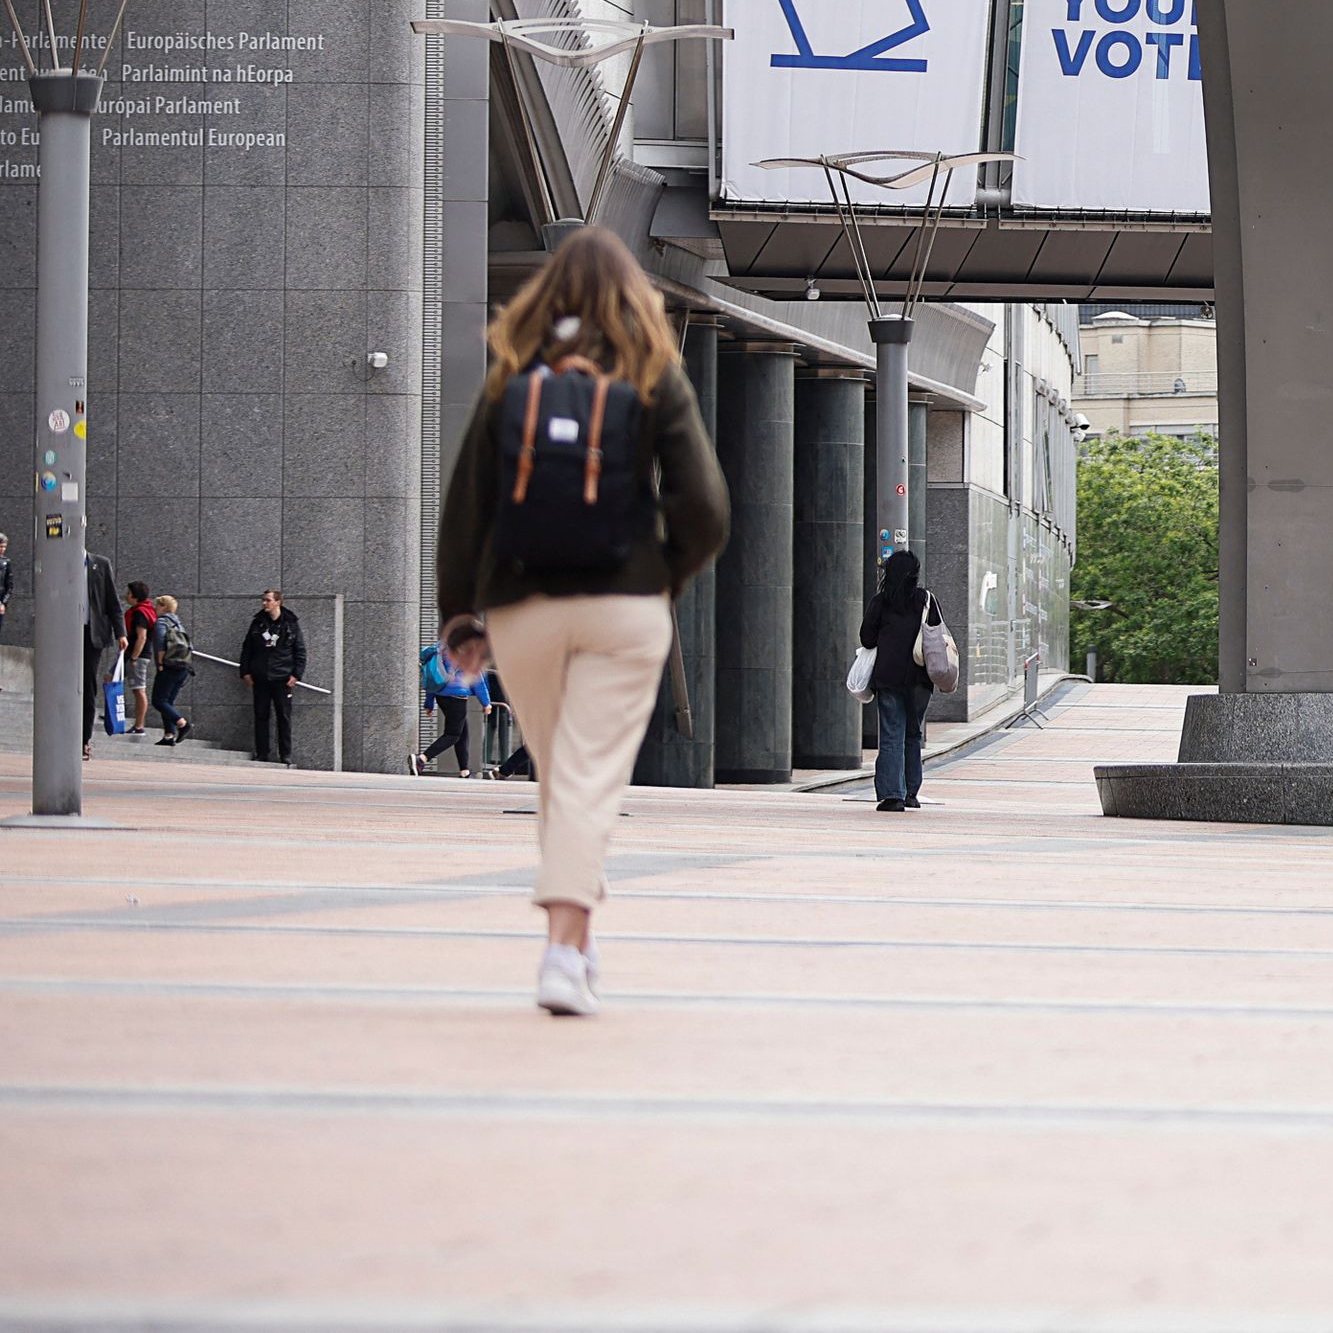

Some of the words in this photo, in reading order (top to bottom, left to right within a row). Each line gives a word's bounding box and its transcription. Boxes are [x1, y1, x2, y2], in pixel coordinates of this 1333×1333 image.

[127, 31, 234, 53] Europäisches
[239, 32, 324, 50] Parlament
[122, 64, 208, 82] Parlaimint
[212, 68, 232, 82] na
[236, 64, 294, 87] hEorpa
[95, 96, 150, 118] urópai
[155, 96, 241, 114] Parlament
[102, 128, 204, 146] Parlamentul
[208, 128, 286, 150] European
